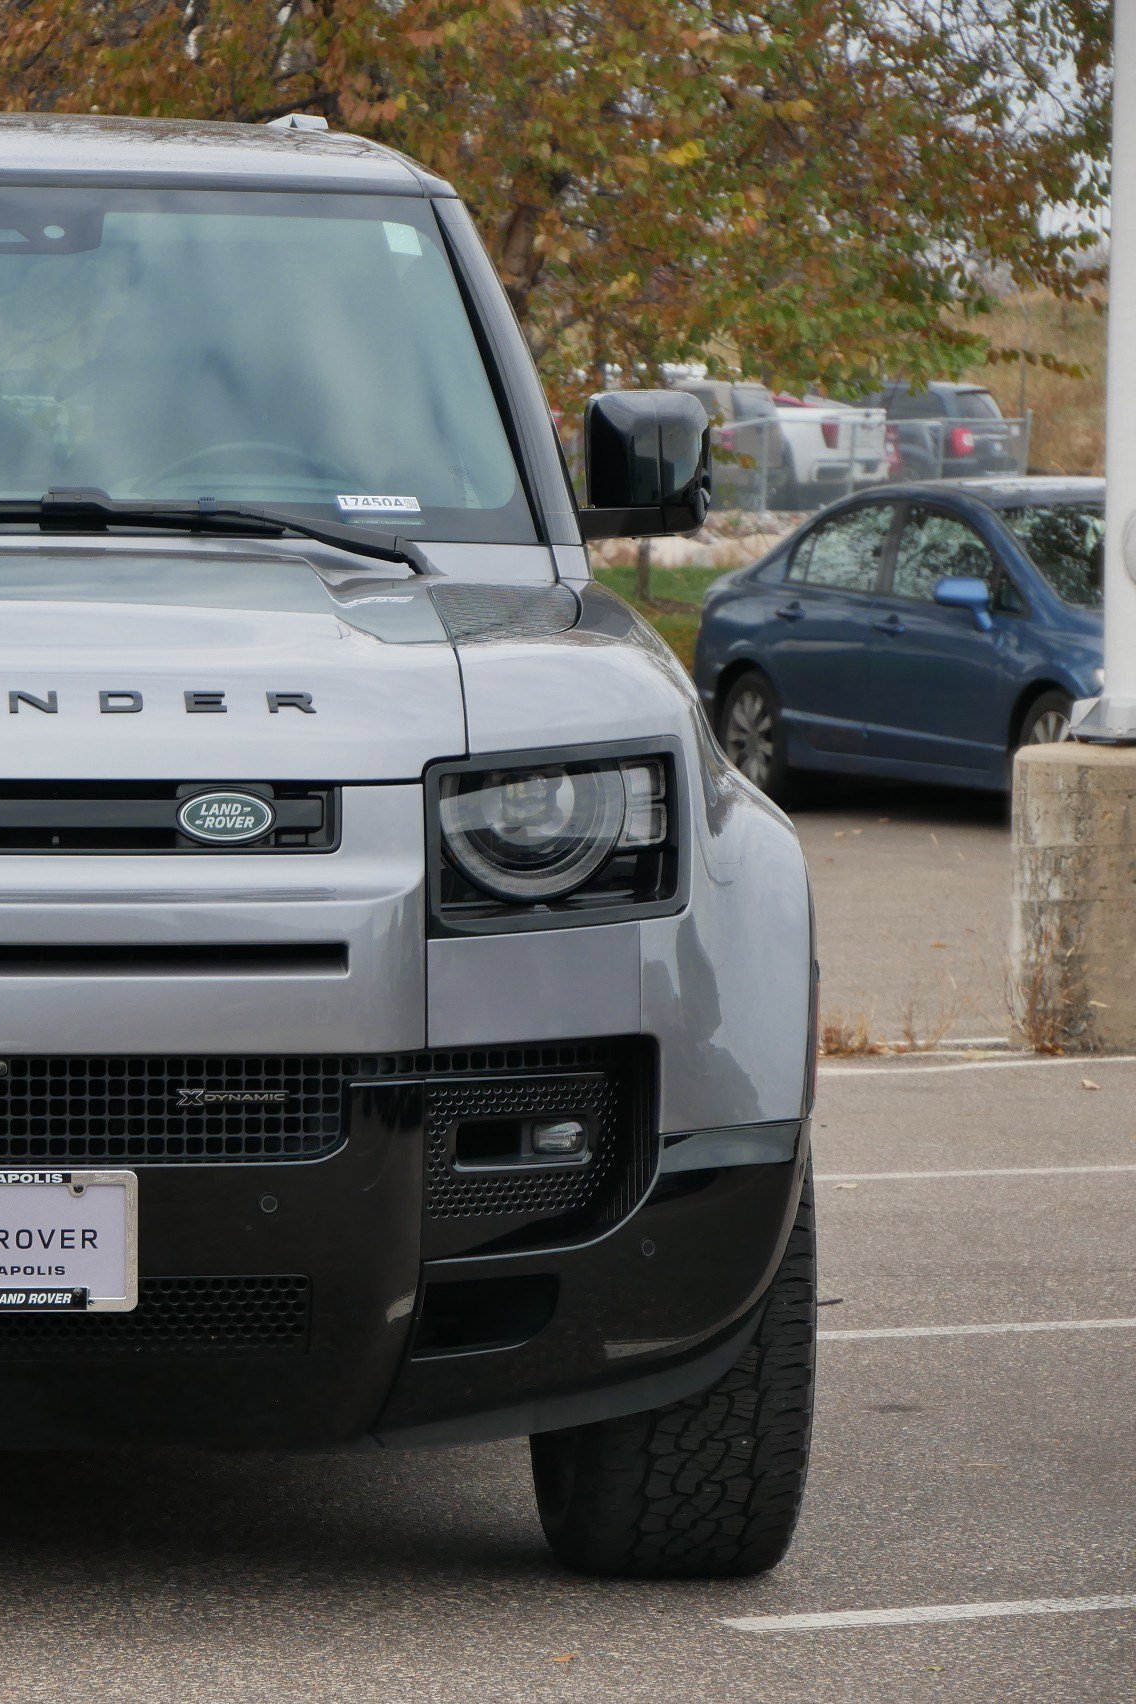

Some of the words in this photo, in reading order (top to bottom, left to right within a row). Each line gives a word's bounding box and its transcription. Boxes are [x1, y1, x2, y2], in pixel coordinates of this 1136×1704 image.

[200, 804, 242, 817] LAND
[203, 816, 255, 829] ROVER
[28, 1293, 72, 1304] ROVER
